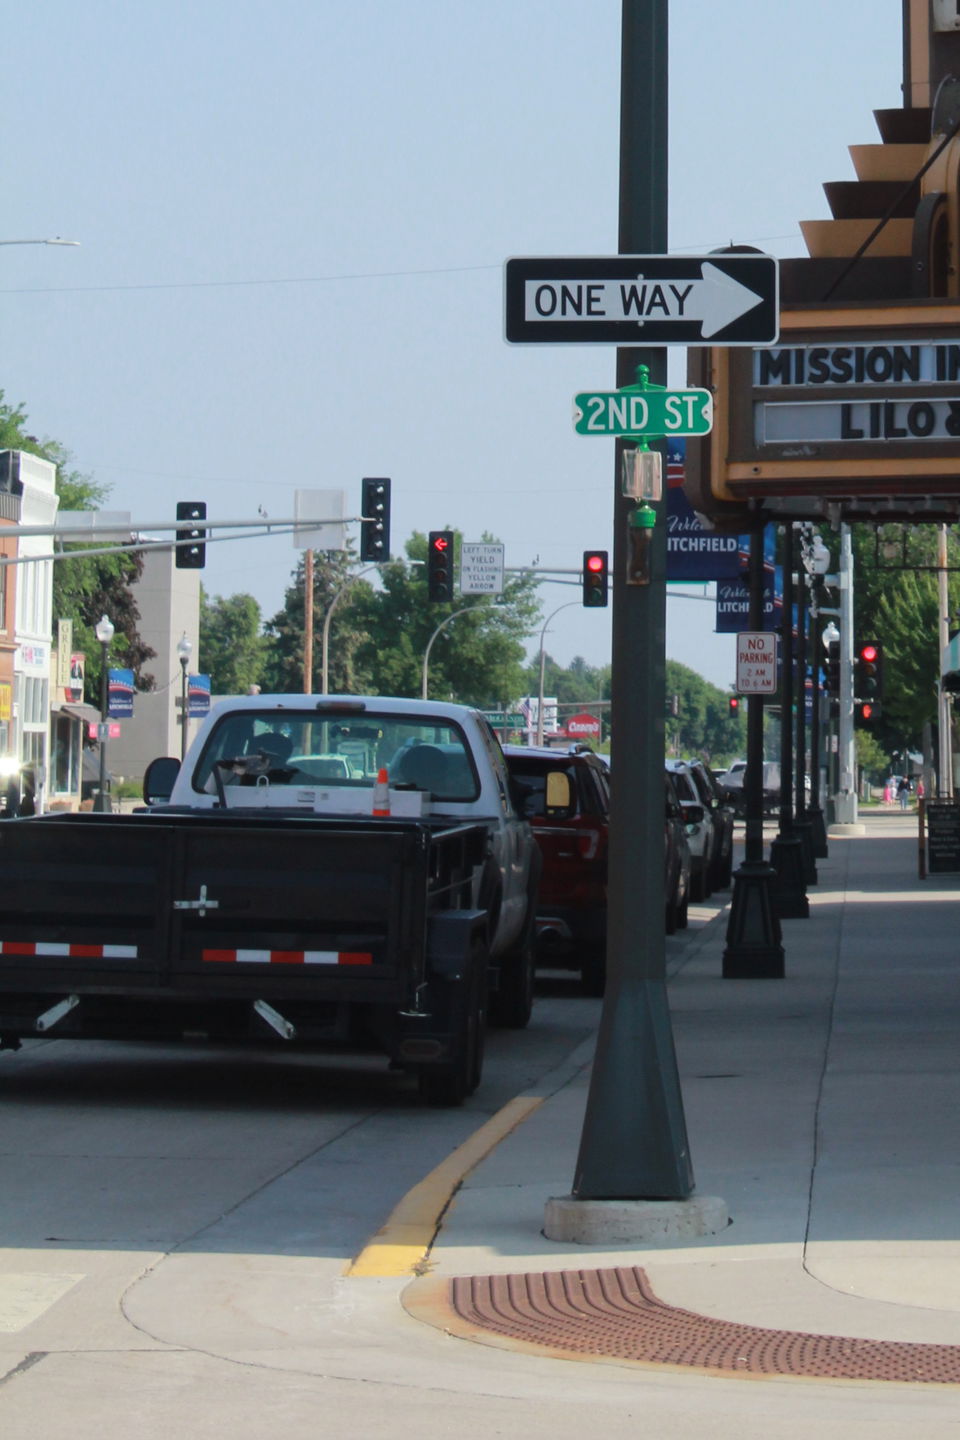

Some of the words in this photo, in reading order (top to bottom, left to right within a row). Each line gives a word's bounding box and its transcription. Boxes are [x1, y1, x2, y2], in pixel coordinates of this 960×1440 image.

[534, 284, 606, 317] ONE
[619, 284, 694, 316] WAY
[759, 344, 920, 385] MISSION
[586, 396, 649, 431] 2ND
[664, 395, 699, 430] ST
[841, 400, 937, 440] LILO
[463, 546, 480, 554] LEFT
[484, 546, 502, 554] TURN
[667, 537, 737, 552] ITCHFIELD
[470, 556, 495, 564] YIELD
[748, 638, 765, 650] NO
[739, 651, 774, 664] PARKING
[756, 668, 766, 676] AM
[762, 679, 772, 687] AM
